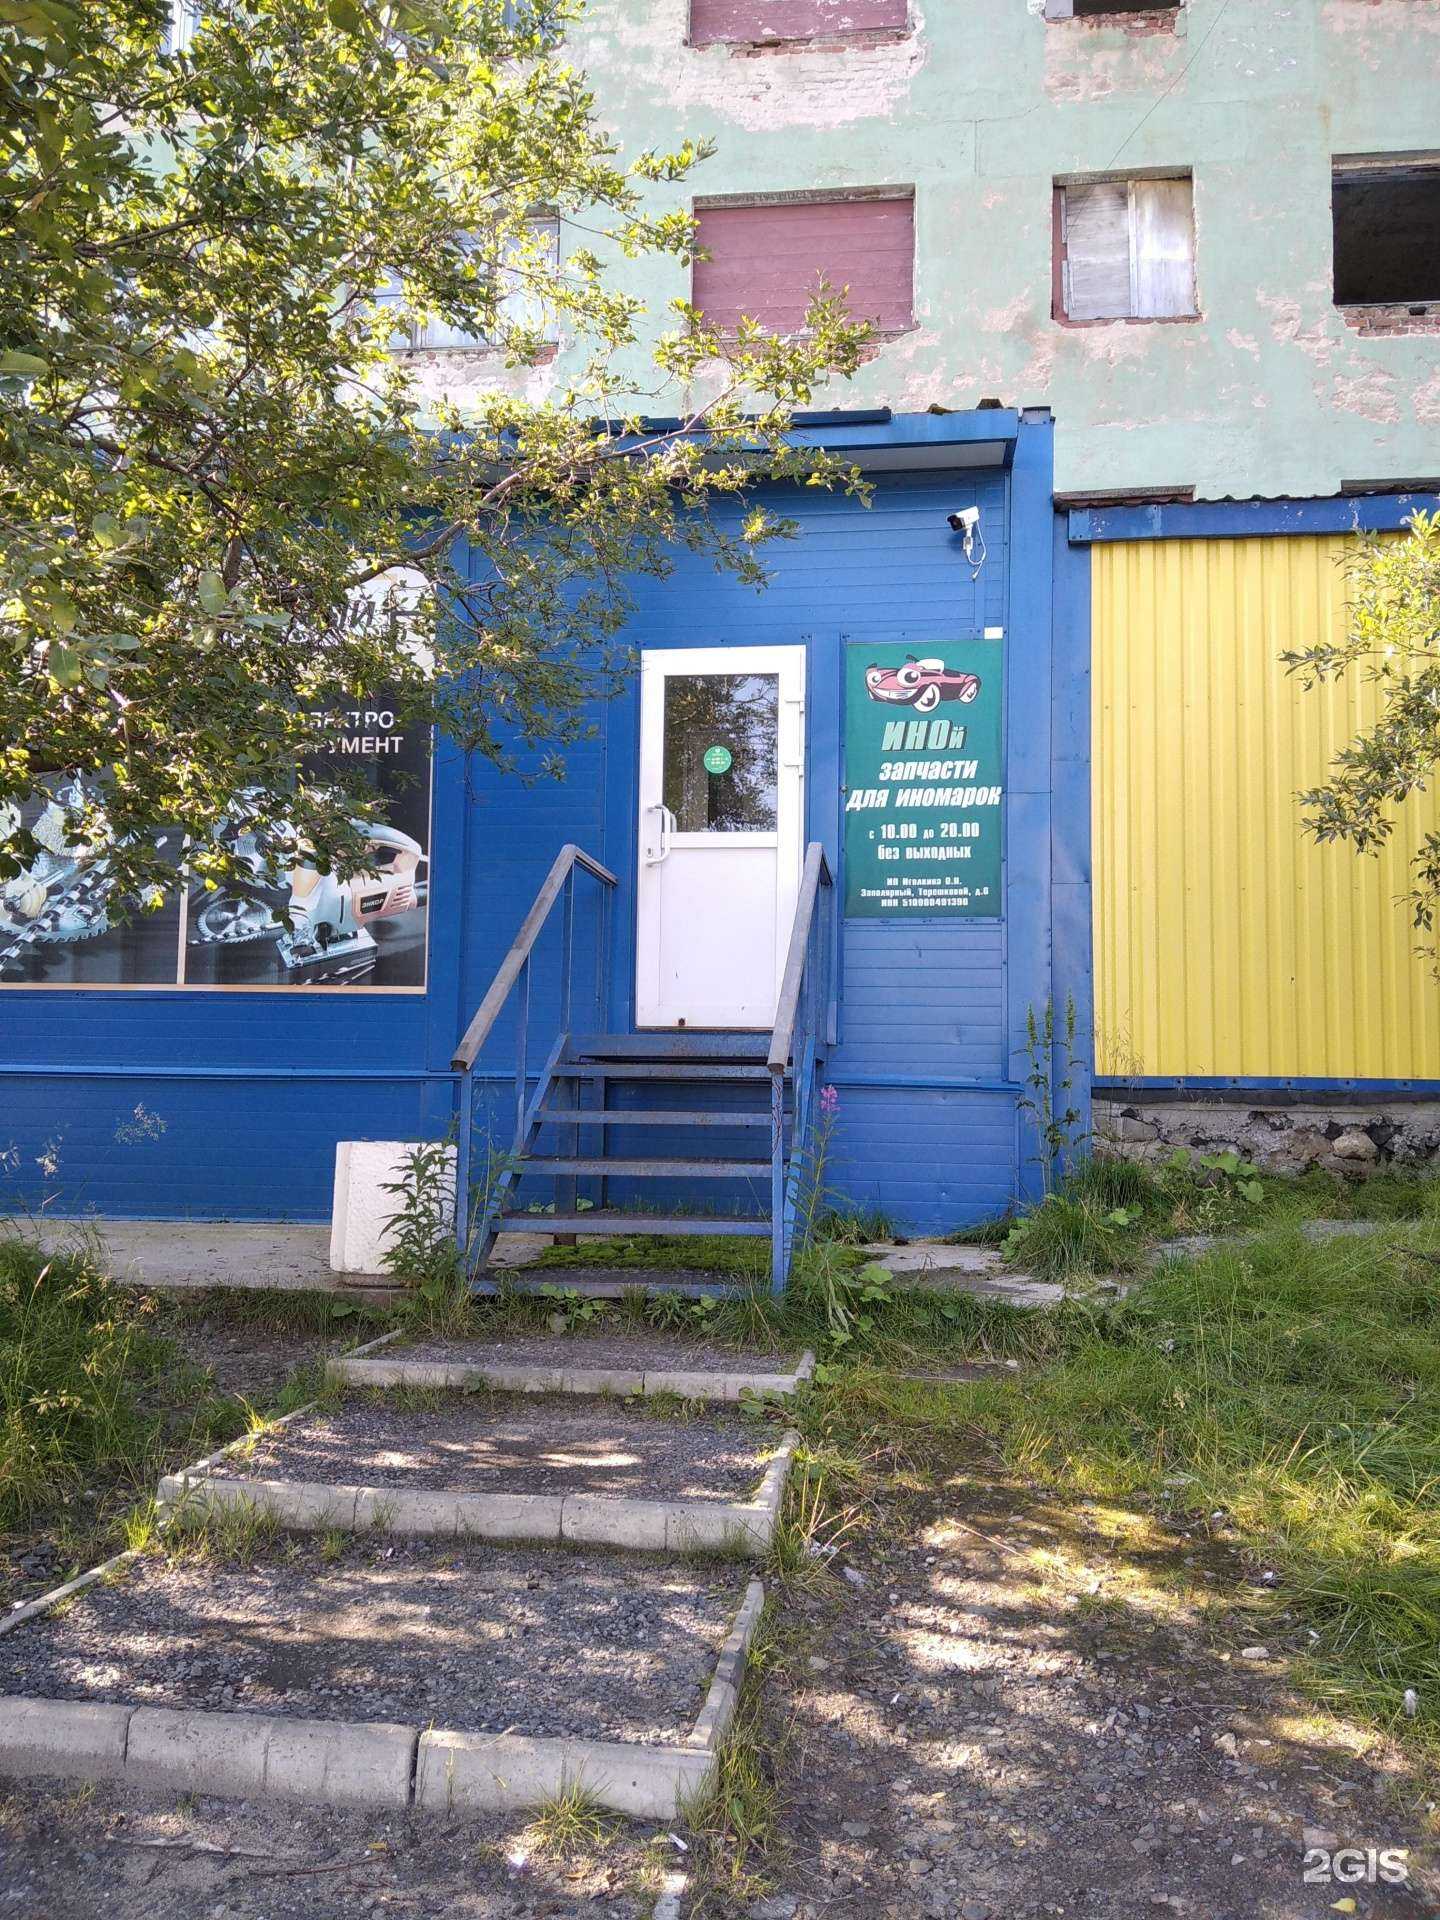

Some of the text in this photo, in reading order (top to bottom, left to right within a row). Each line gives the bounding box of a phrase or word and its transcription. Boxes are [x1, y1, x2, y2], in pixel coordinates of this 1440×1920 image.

[879, 760, 979, 781] запчасти
[845, 786, 1003, 812] для иномарок
[880, 823, 917, 839] 10.00
[923, 829, 935, 839] до
[940, 822, 980, 838] 20.00
[877, 845, 972, 860] без выходных
